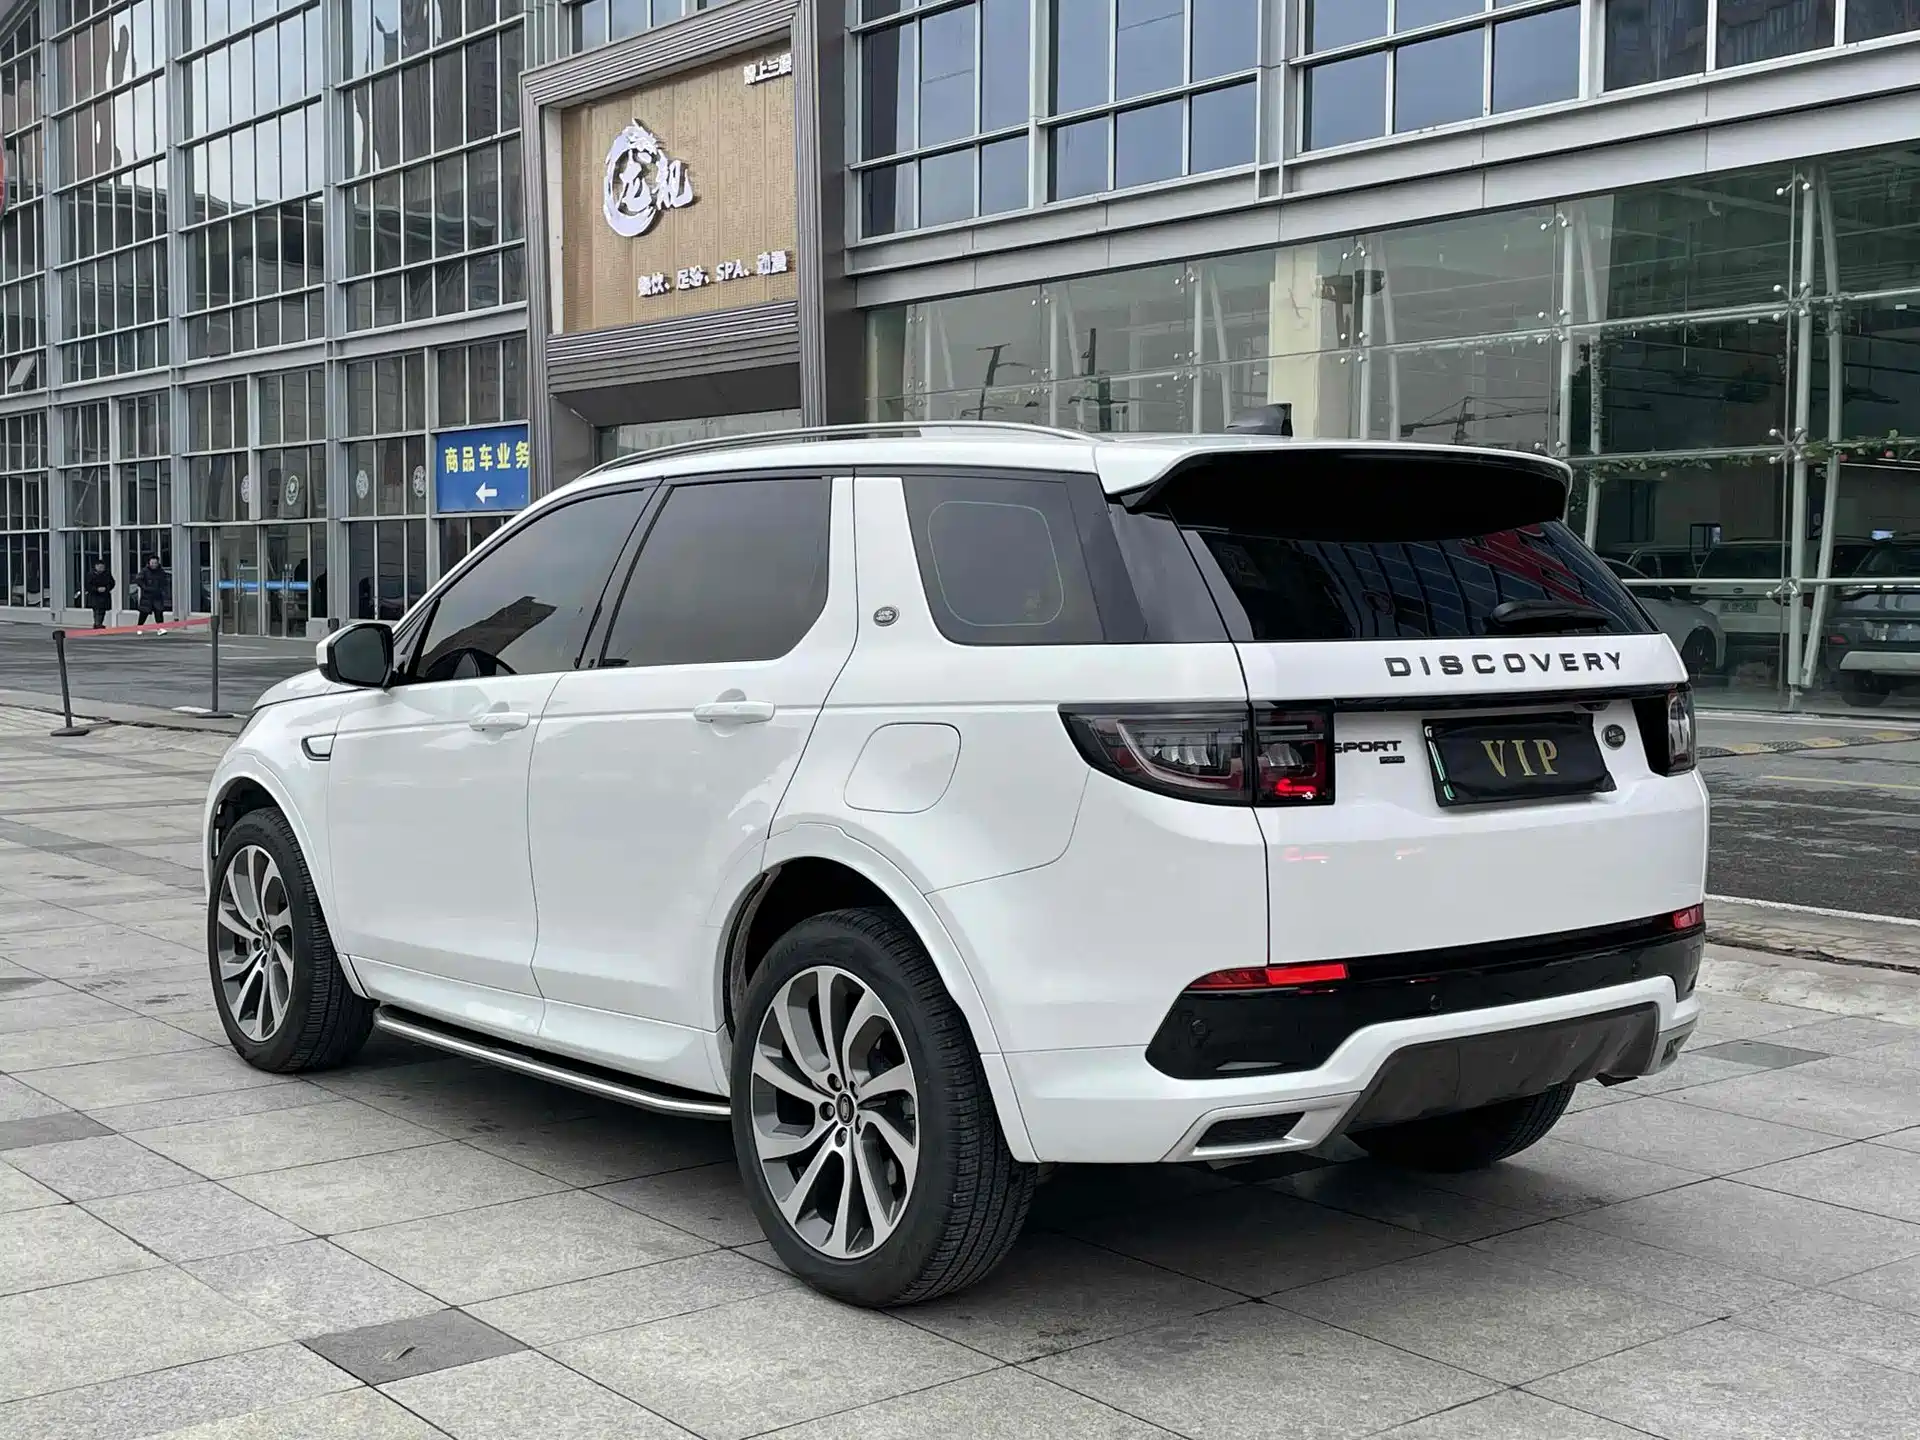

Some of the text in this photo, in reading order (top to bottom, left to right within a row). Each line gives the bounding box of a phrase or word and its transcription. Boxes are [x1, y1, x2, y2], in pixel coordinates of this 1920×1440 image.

[444, 440, 529, 474] 商品车业务
[1385, 652, 1621, 677] DISCOVERY
[1480, 739, 1559, 778] VIP
